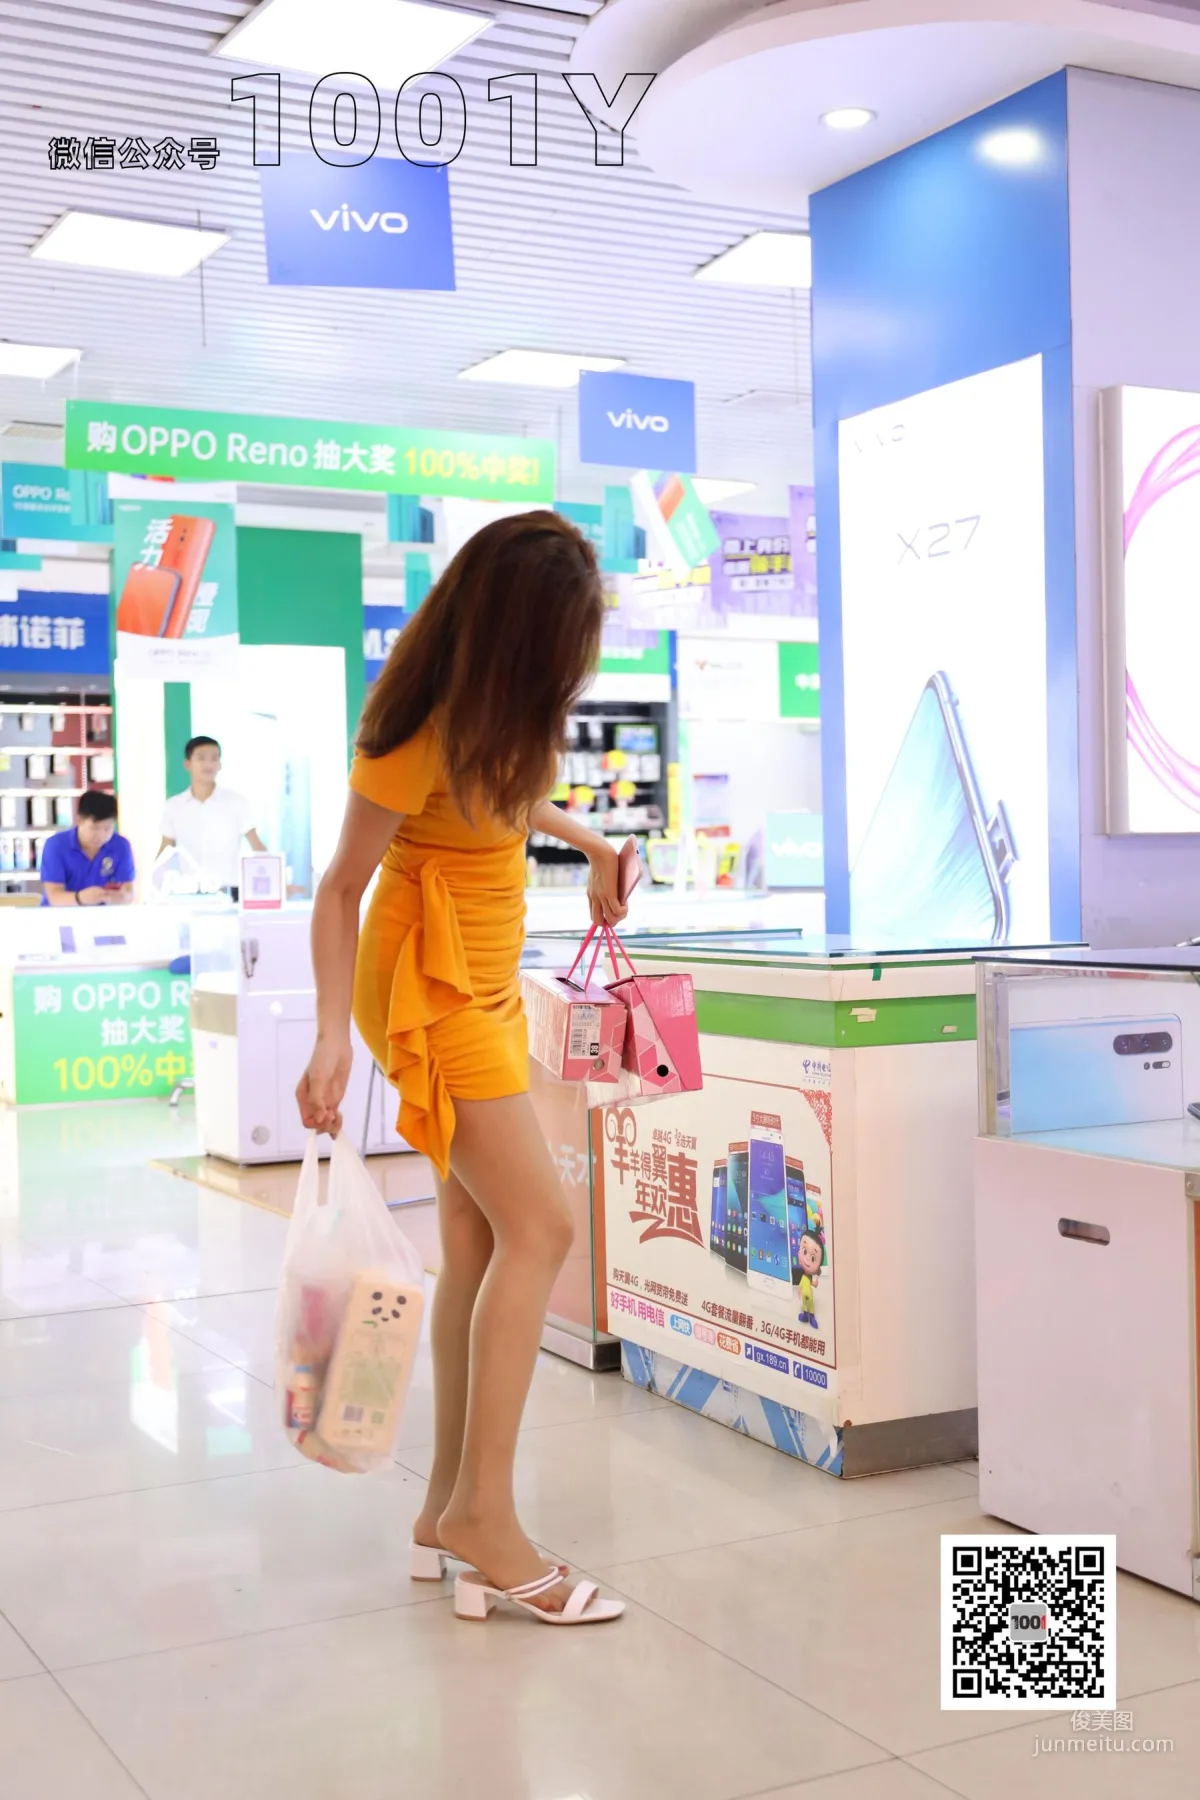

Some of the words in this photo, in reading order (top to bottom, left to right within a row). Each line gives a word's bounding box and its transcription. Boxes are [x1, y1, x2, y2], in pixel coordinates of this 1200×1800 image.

[309, 203, 409, 235] vivo
[606, 408, 669, 433] vivo
[87, 420, 117, 454] 购
[121, 424, 217, 461] OPPO
[227, 433, 308, 468] Reno
[313, 439, 396, 476] 抽大奖
[12, 484, 52, 500] OPPO
[133, 518, 174, 571] 活力
[896, 514, 981, 565] X27
[34, 983, 62, 1015] 购
[72, 981, 161, 1013] OPPO
[100, 1015, 186, 1047] 抽大奖
[53, 1050, 194, 1093] 100%中
[755, 1350, 788, 1371] gx.189.cn
[804, 1370, 826, 1387] 10000
